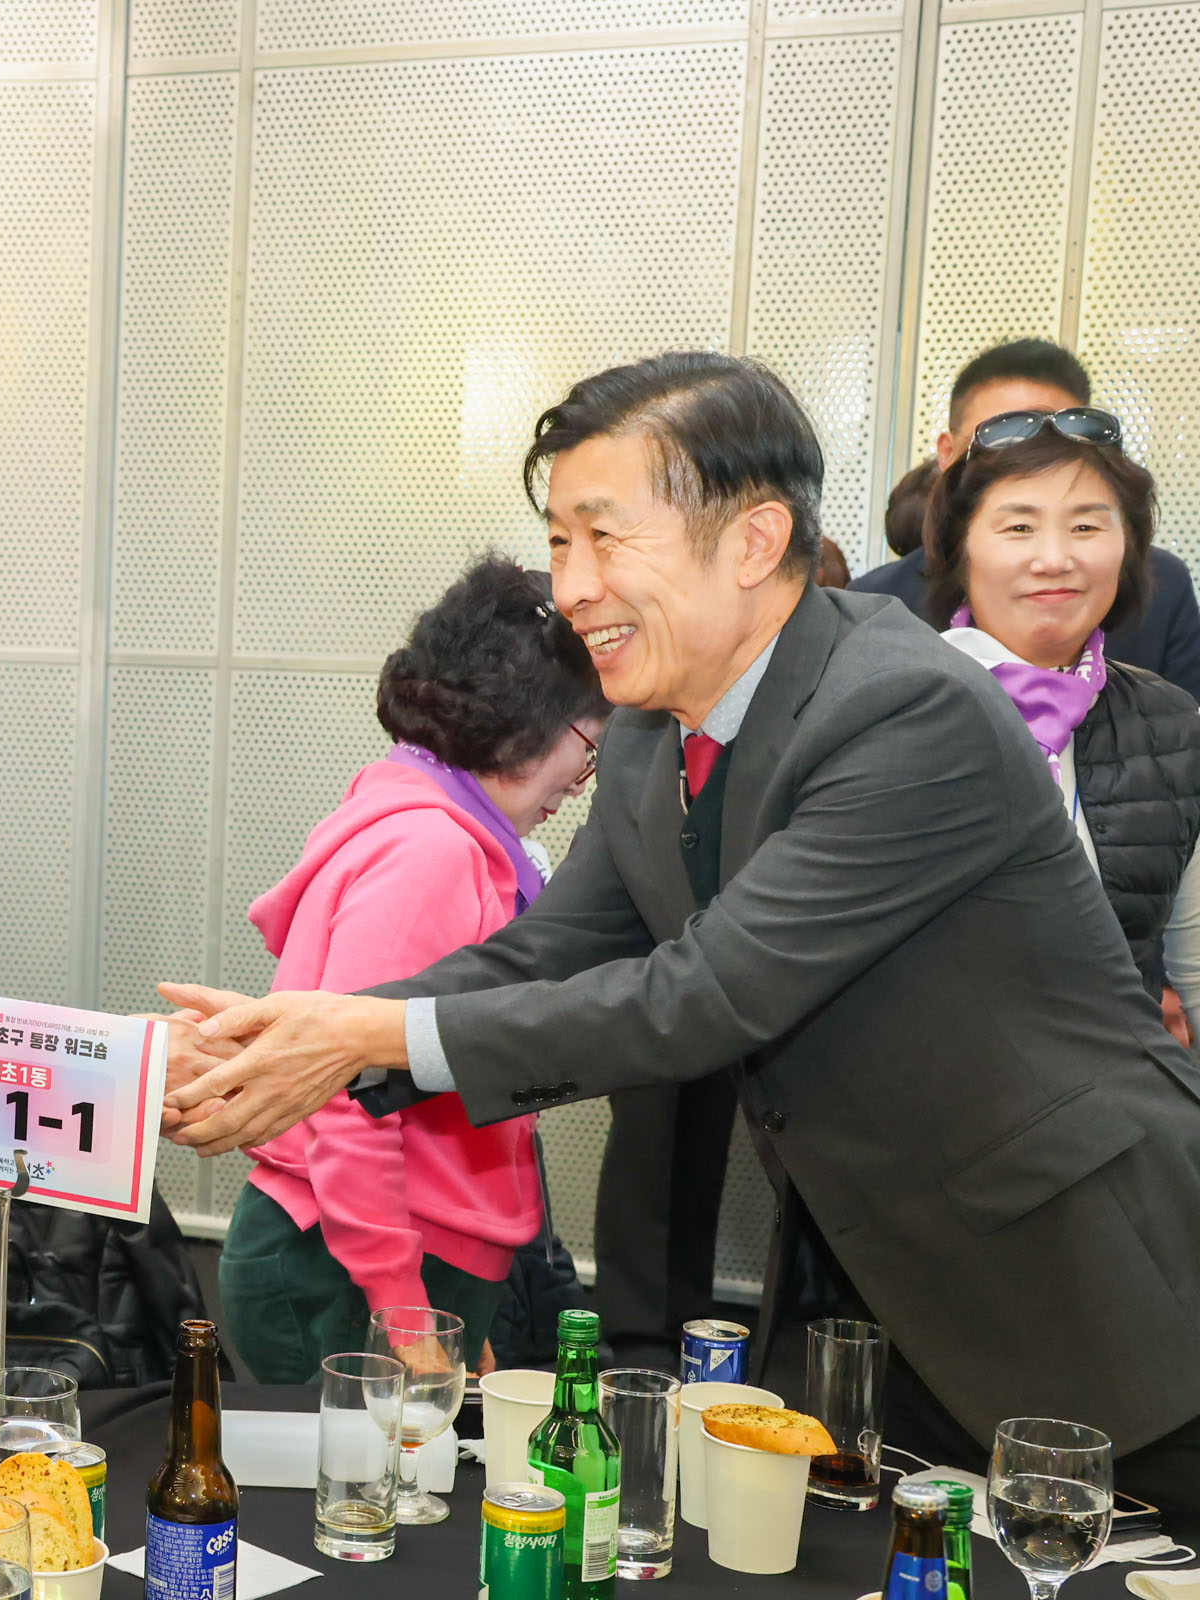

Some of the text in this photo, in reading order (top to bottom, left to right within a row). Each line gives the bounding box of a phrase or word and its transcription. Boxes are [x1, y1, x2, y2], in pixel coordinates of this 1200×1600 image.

[30, 1032, 59, 1051] 통장
[64, 1038, 107, 1060] 워크숍
[6, 1090, 95, 1153] 1-1
[206, 1525, 234, 1555] Cass
[504, 1532, 558, 1549] 칠성사이다
